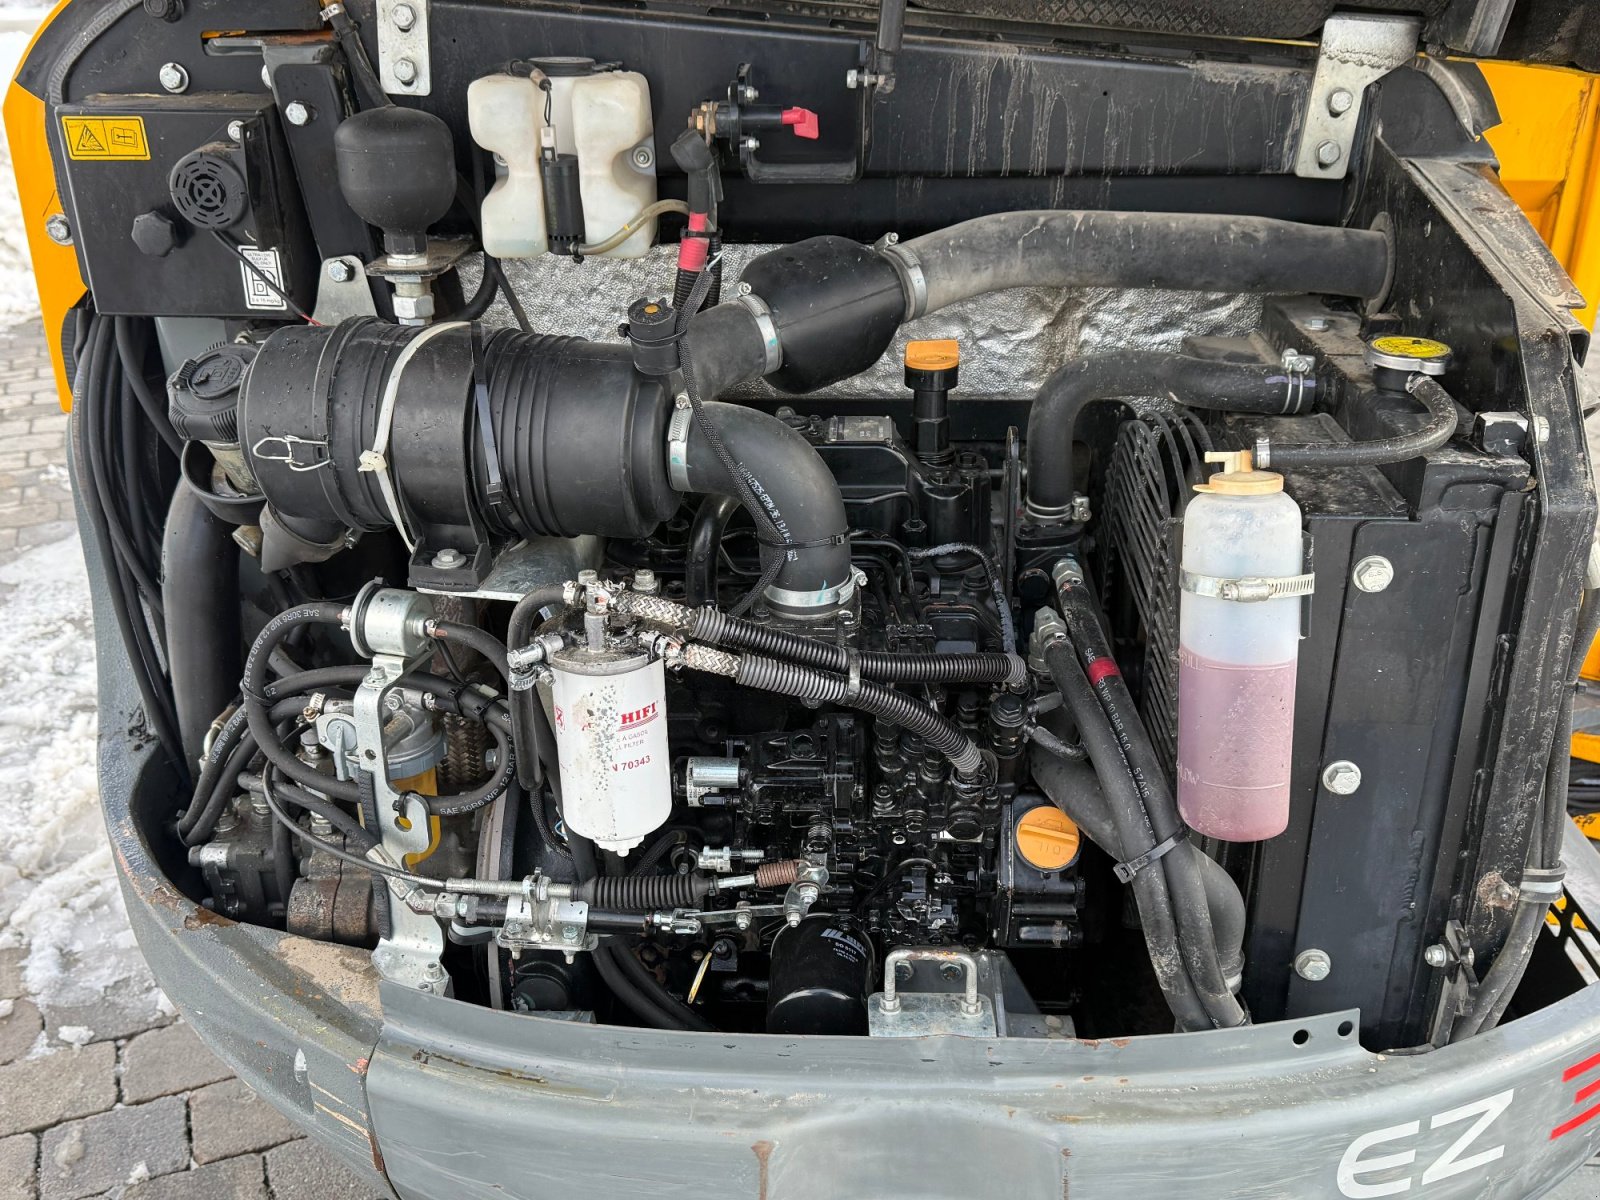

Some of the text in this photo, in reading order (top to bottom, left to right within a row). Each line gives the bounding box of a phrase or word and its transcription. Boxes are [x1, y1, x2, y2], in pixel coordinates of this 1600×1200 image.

[282, 610, 302, 621] 30R6
[302, 608, 320, 617] SAE
[270, 618, 284, 631] WP
[262, 627, 271, 639] 12
[1085, 647, 1096, 663] SAE
[1101, 688, 1112, 702] WP
[620, 702, 657, 725] HIFI
[1108, 703, 1116, 713] 10
[232, 712, 245, 727] BAR
[1111, 713, 1123, 732] BAR
[621, 754, 651, 771] 70343
[439, 807, 460, 815] SAE
[460, 799, 485, 813] 30R6
[483, 788, 500, 803] WP
[499, 777, 510, 787] 12
[506, 752, 516, 774] BAR
[1336, 1088, 1515, 1199] EZ
